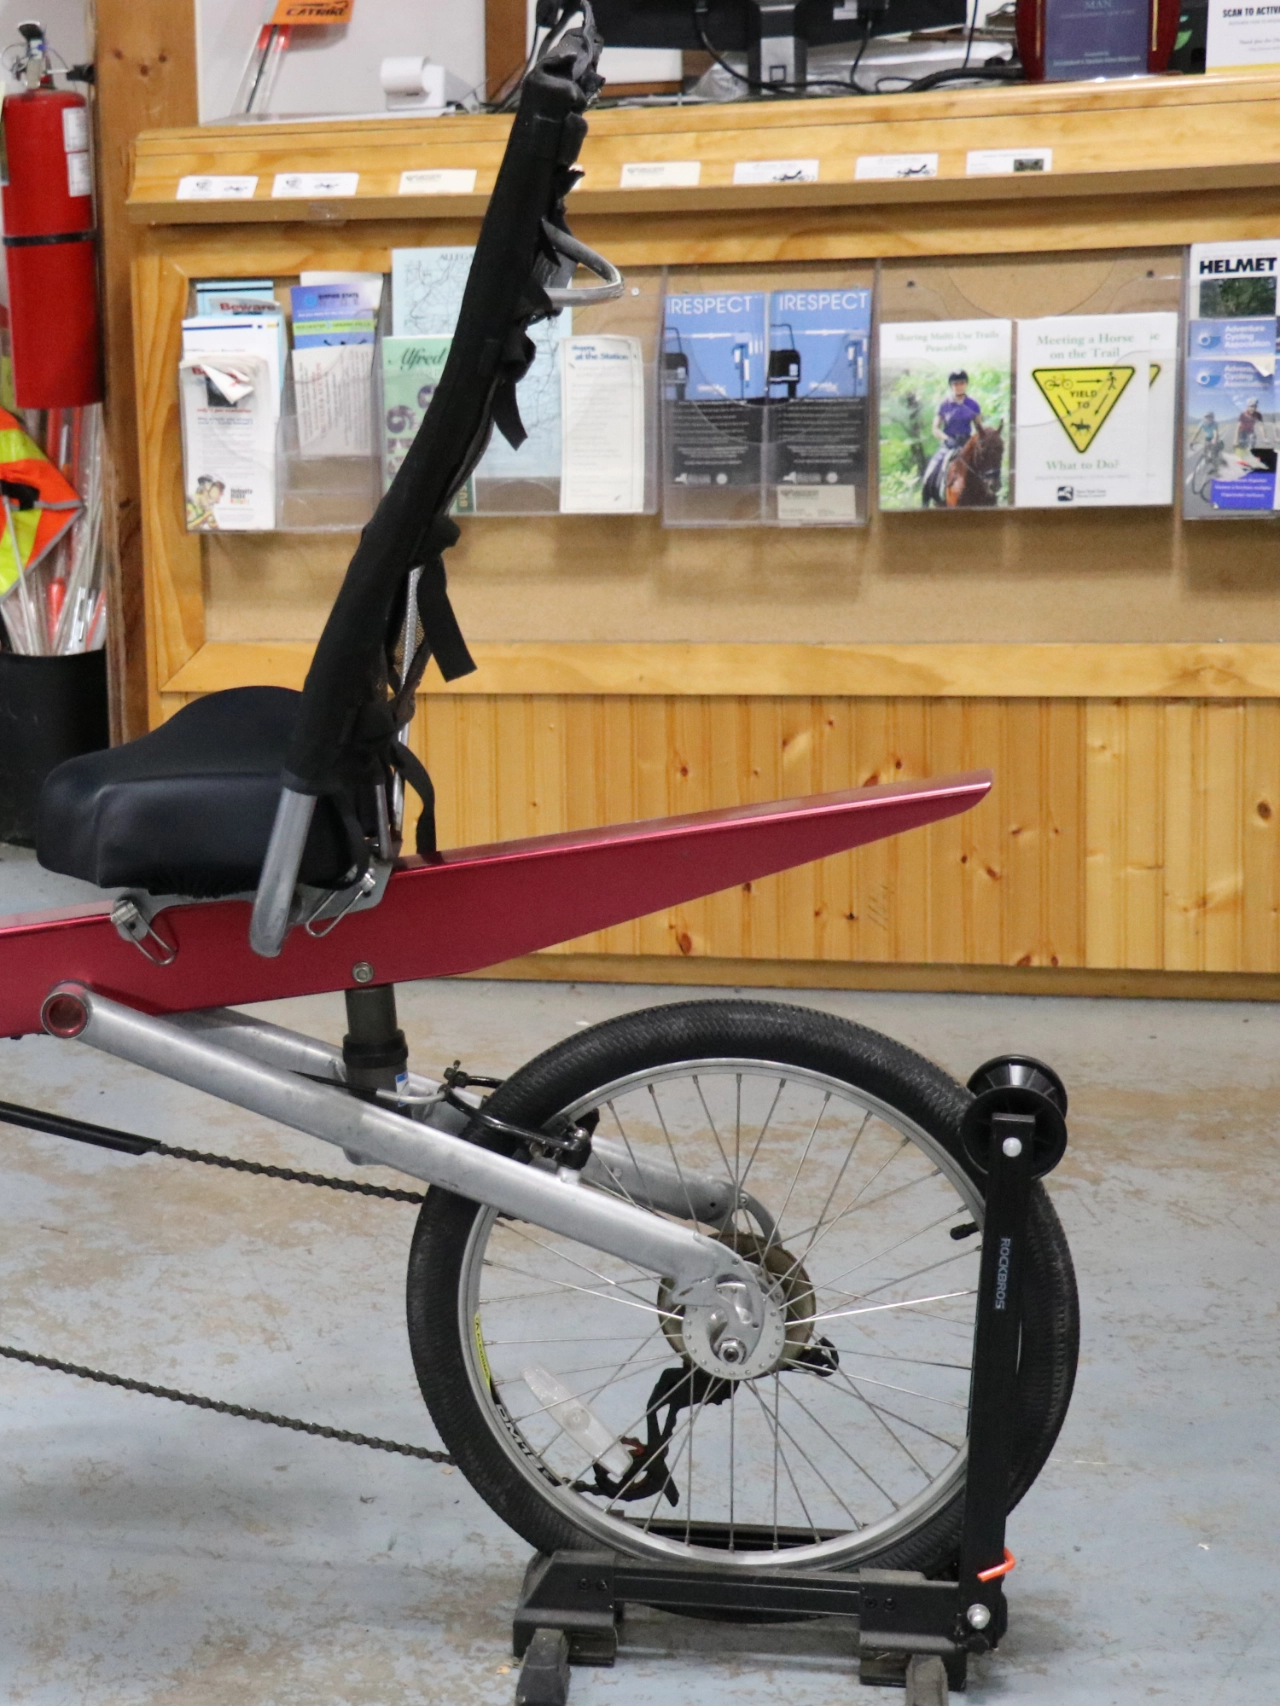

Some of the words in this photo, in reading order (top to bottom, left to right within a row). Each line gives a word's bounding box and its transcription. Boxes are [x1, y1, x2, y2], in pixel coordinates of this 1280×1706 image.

[1222, 8, 1242, 18] SCAN
[1245, 7, 1254, 16] TO
[1199, 256, 1278, 275] HELMET
[220, 302, 277, 311] Beware
[1224, 325, 1266, 333] Adventure
[1036, 334, 1085, 346] Meeting
[1098, 333, 1135, 343] Horse
[1223, 333, 1255, 342] Cycling
[388, 347, 447, 370] Alfred
[1049, 350, 1066, 359] on
[1069, 349, 1087, 359] the
[1092, 347, 1120, 358] Trail
[1070, 389, 1098, 398] YIELD
[1076, 401, 1091, 409] TO
[1045, 460, 1078, 471] What
[1081, 461, 1093, 470] to
[1096, 458, 1120, 469] Do?
[994, 1237, 1011, 1310] ROCKBROS
